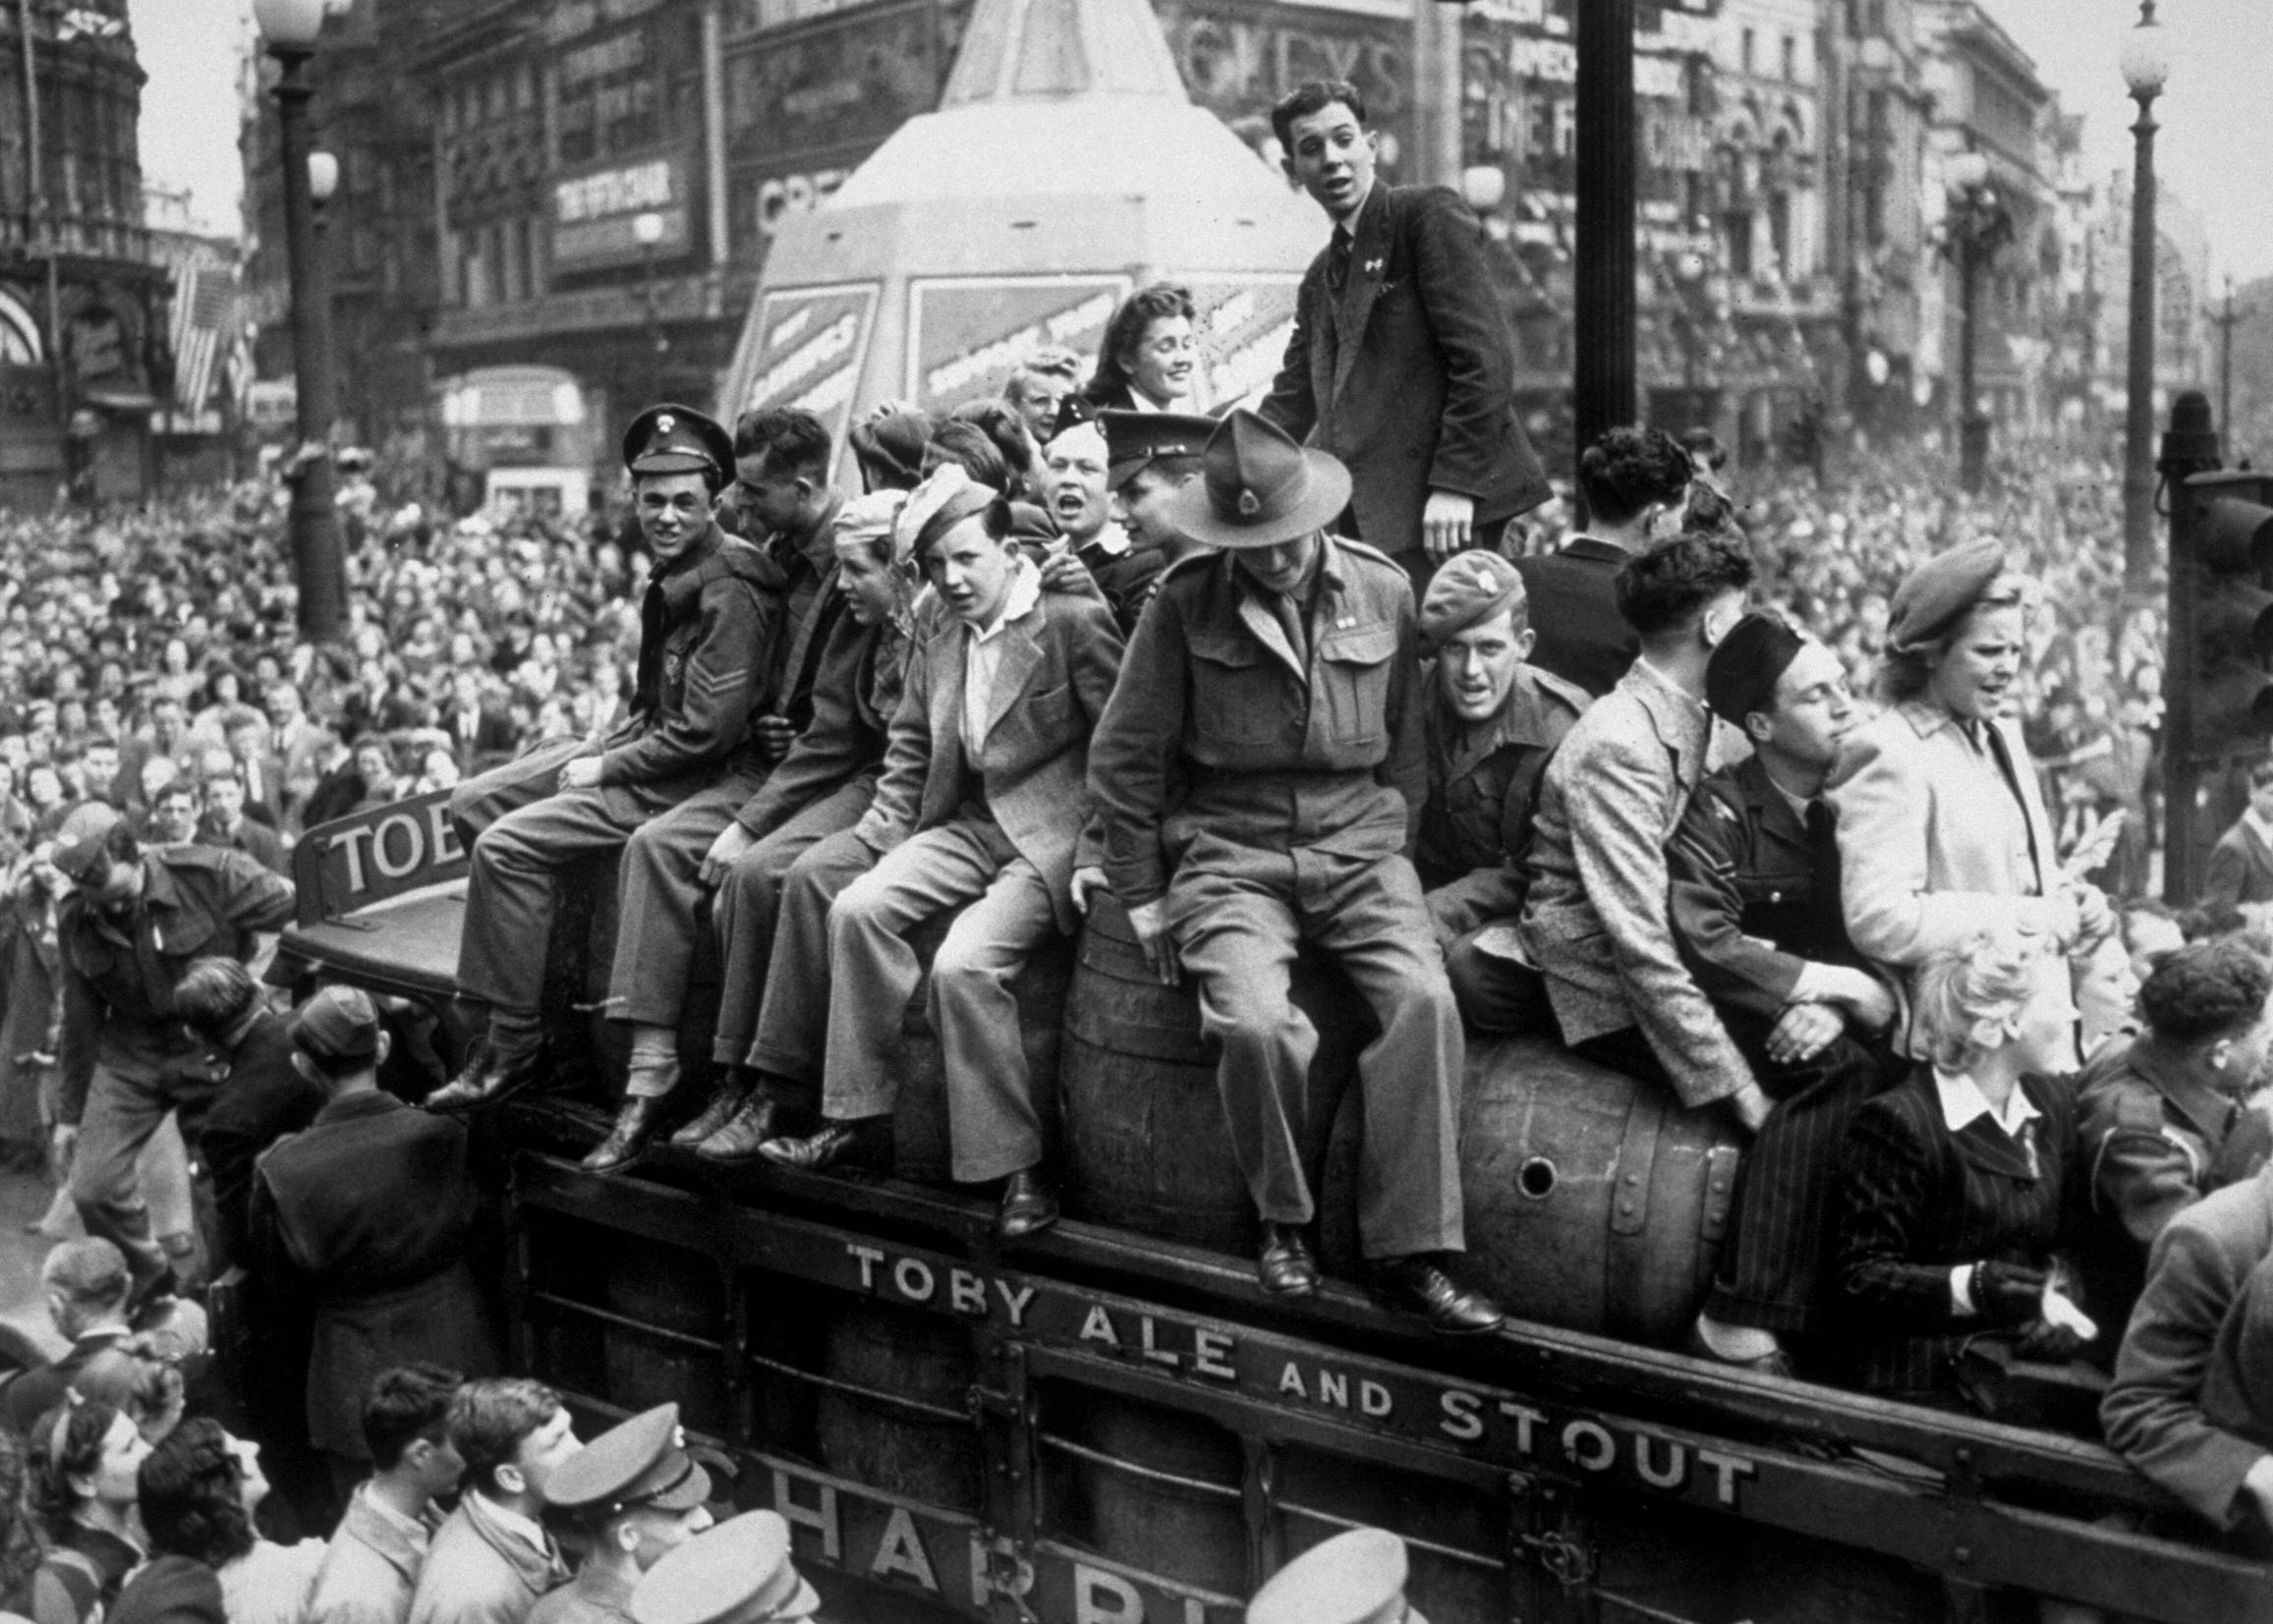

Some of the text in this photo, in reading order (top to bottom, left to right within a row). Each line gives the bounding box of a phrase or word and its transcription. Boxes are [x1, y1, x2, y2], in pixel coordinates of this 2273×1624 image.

[846, 1243, 1755, 1505] TOBY ALE AND STOUT
